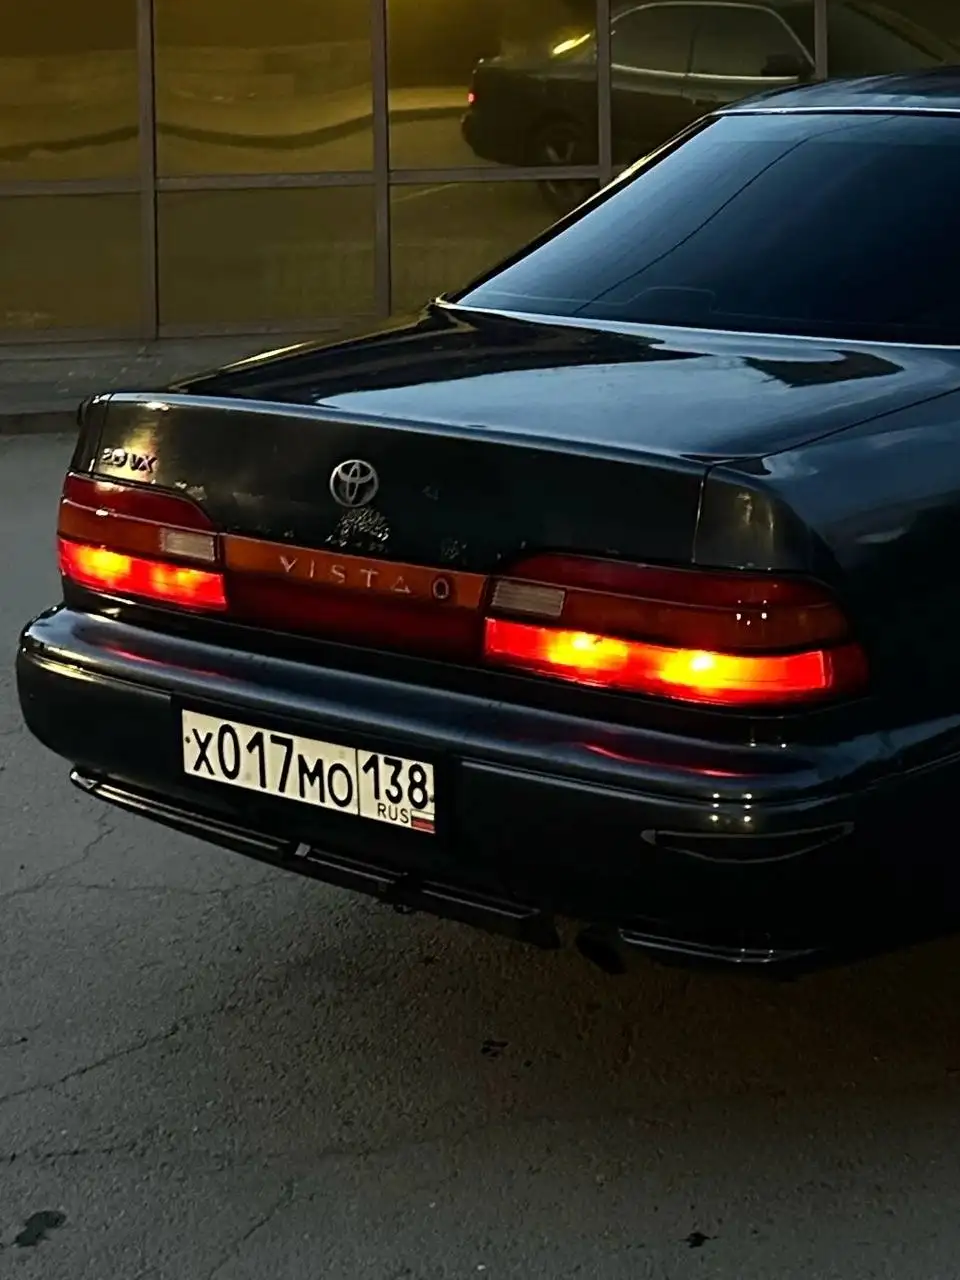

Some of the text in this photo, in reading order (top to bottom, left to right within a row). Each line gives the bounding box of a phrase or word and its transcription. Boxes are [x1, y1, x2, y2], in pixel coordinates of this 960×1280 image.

[279, 555, 411, 593] VISTA
[362, 754, 428, 810] 138
[377, 802, 409, 824] RUS
